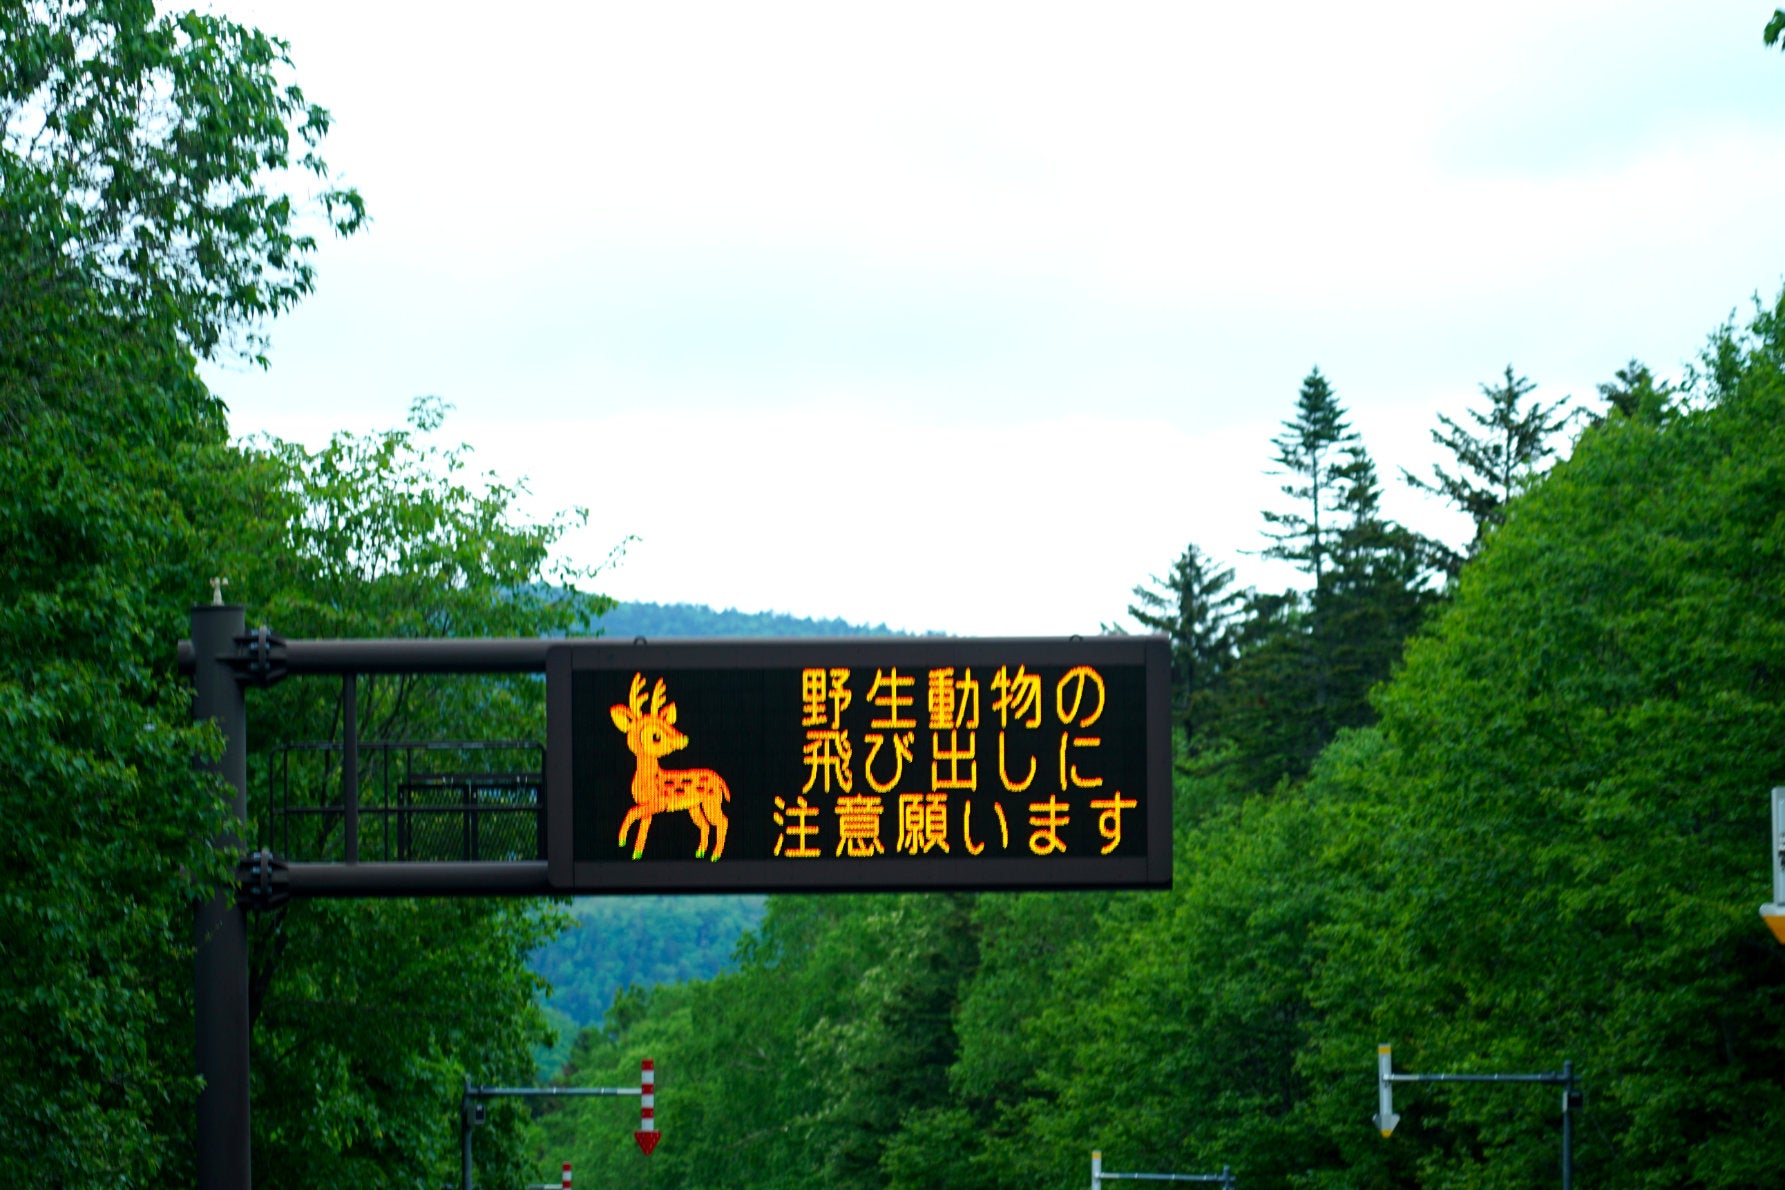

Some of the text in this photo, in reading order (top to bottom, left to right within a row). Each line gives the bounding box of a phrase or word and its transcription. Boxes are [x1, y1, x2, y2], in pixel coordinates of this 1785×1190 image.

[802, 664, 1105, 730] 野生動物の
[802, 729, 1103, 792] 飛び出しに
[773, 791, 1138, 857] 注意願います
